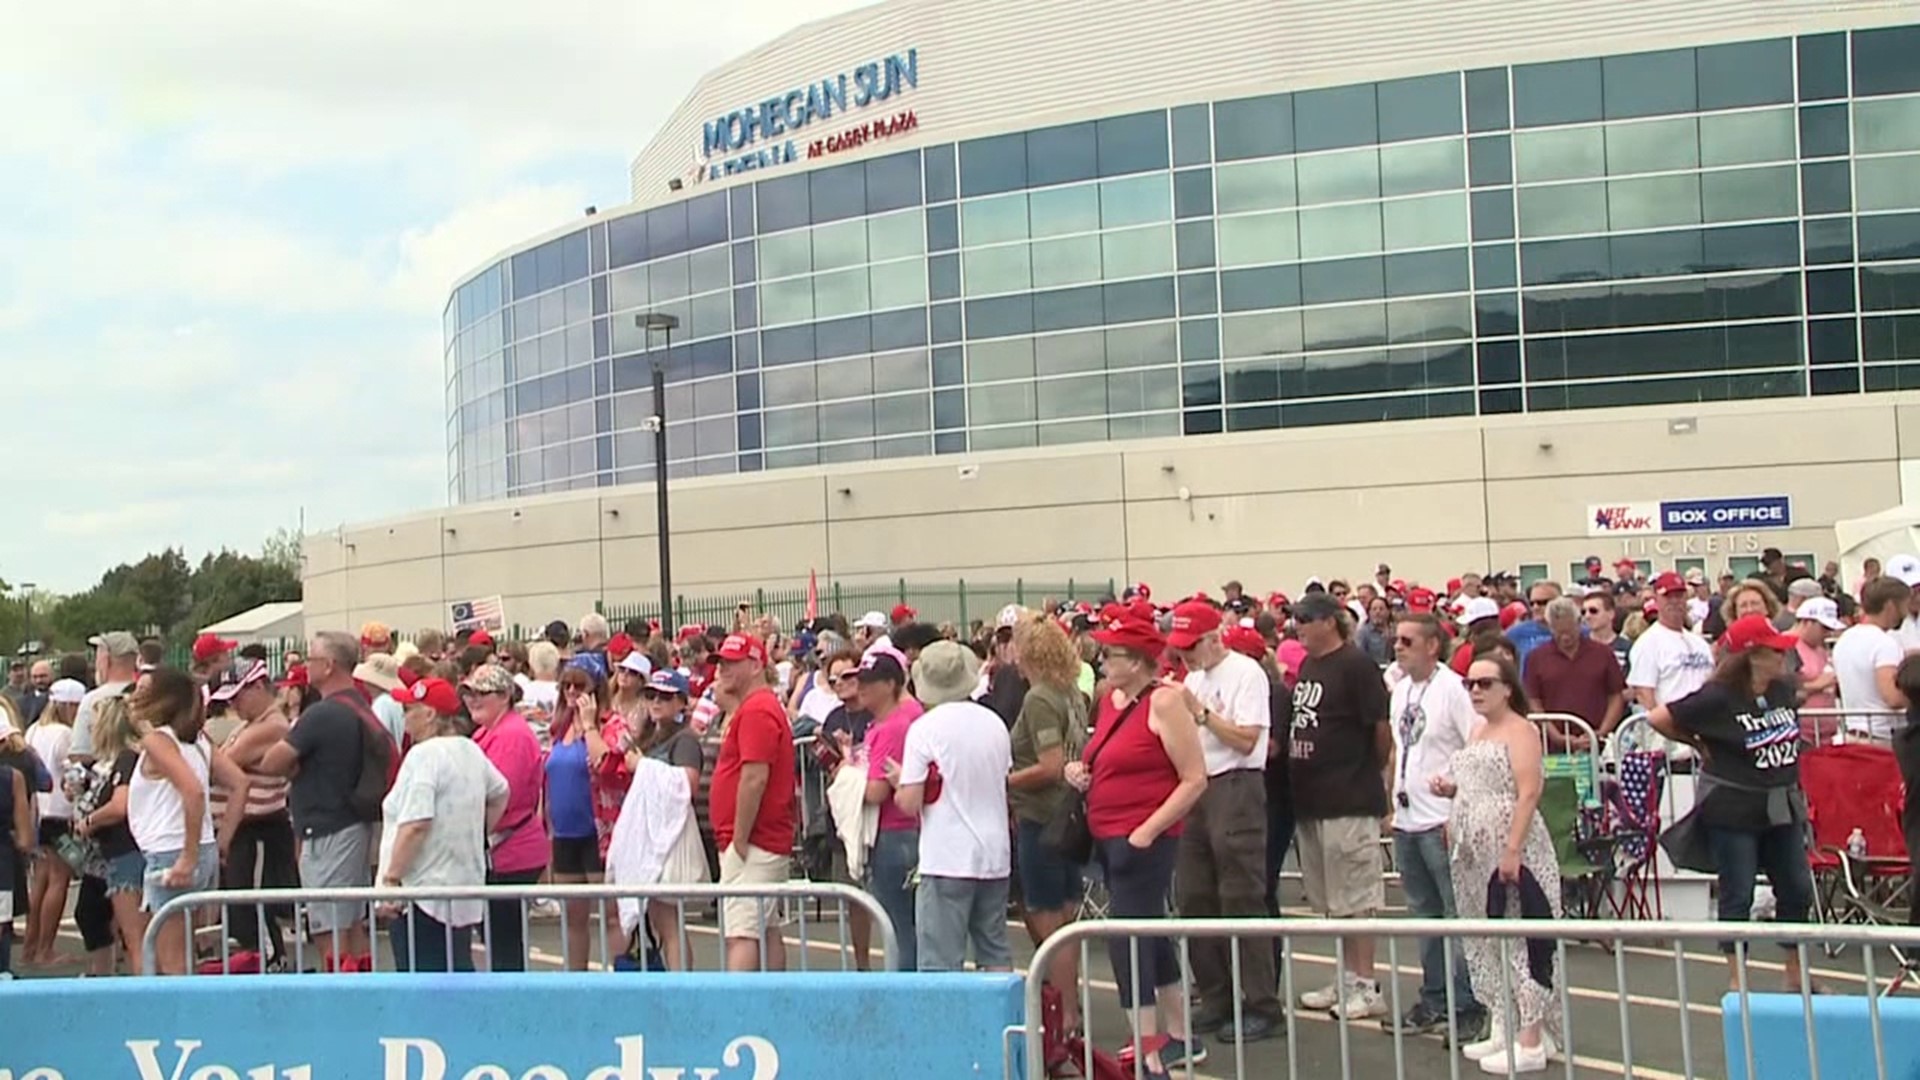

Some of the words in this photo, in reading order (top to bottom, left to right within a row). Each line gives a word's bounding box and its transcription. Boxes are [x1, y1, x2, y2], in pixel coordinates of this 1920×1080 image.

[703, 73, 847, 158] MOHEGAN
[854, 48, 918, 107] SUN
[1608, 516, 1652, 530] BANK
[1667, 510, 1707, 524] BOX
[1712, 506, 1782, 522] OFFICE
[1621, 533, 1759, 556] TICKETS
[1736, 707, 1795, 731] Trump
